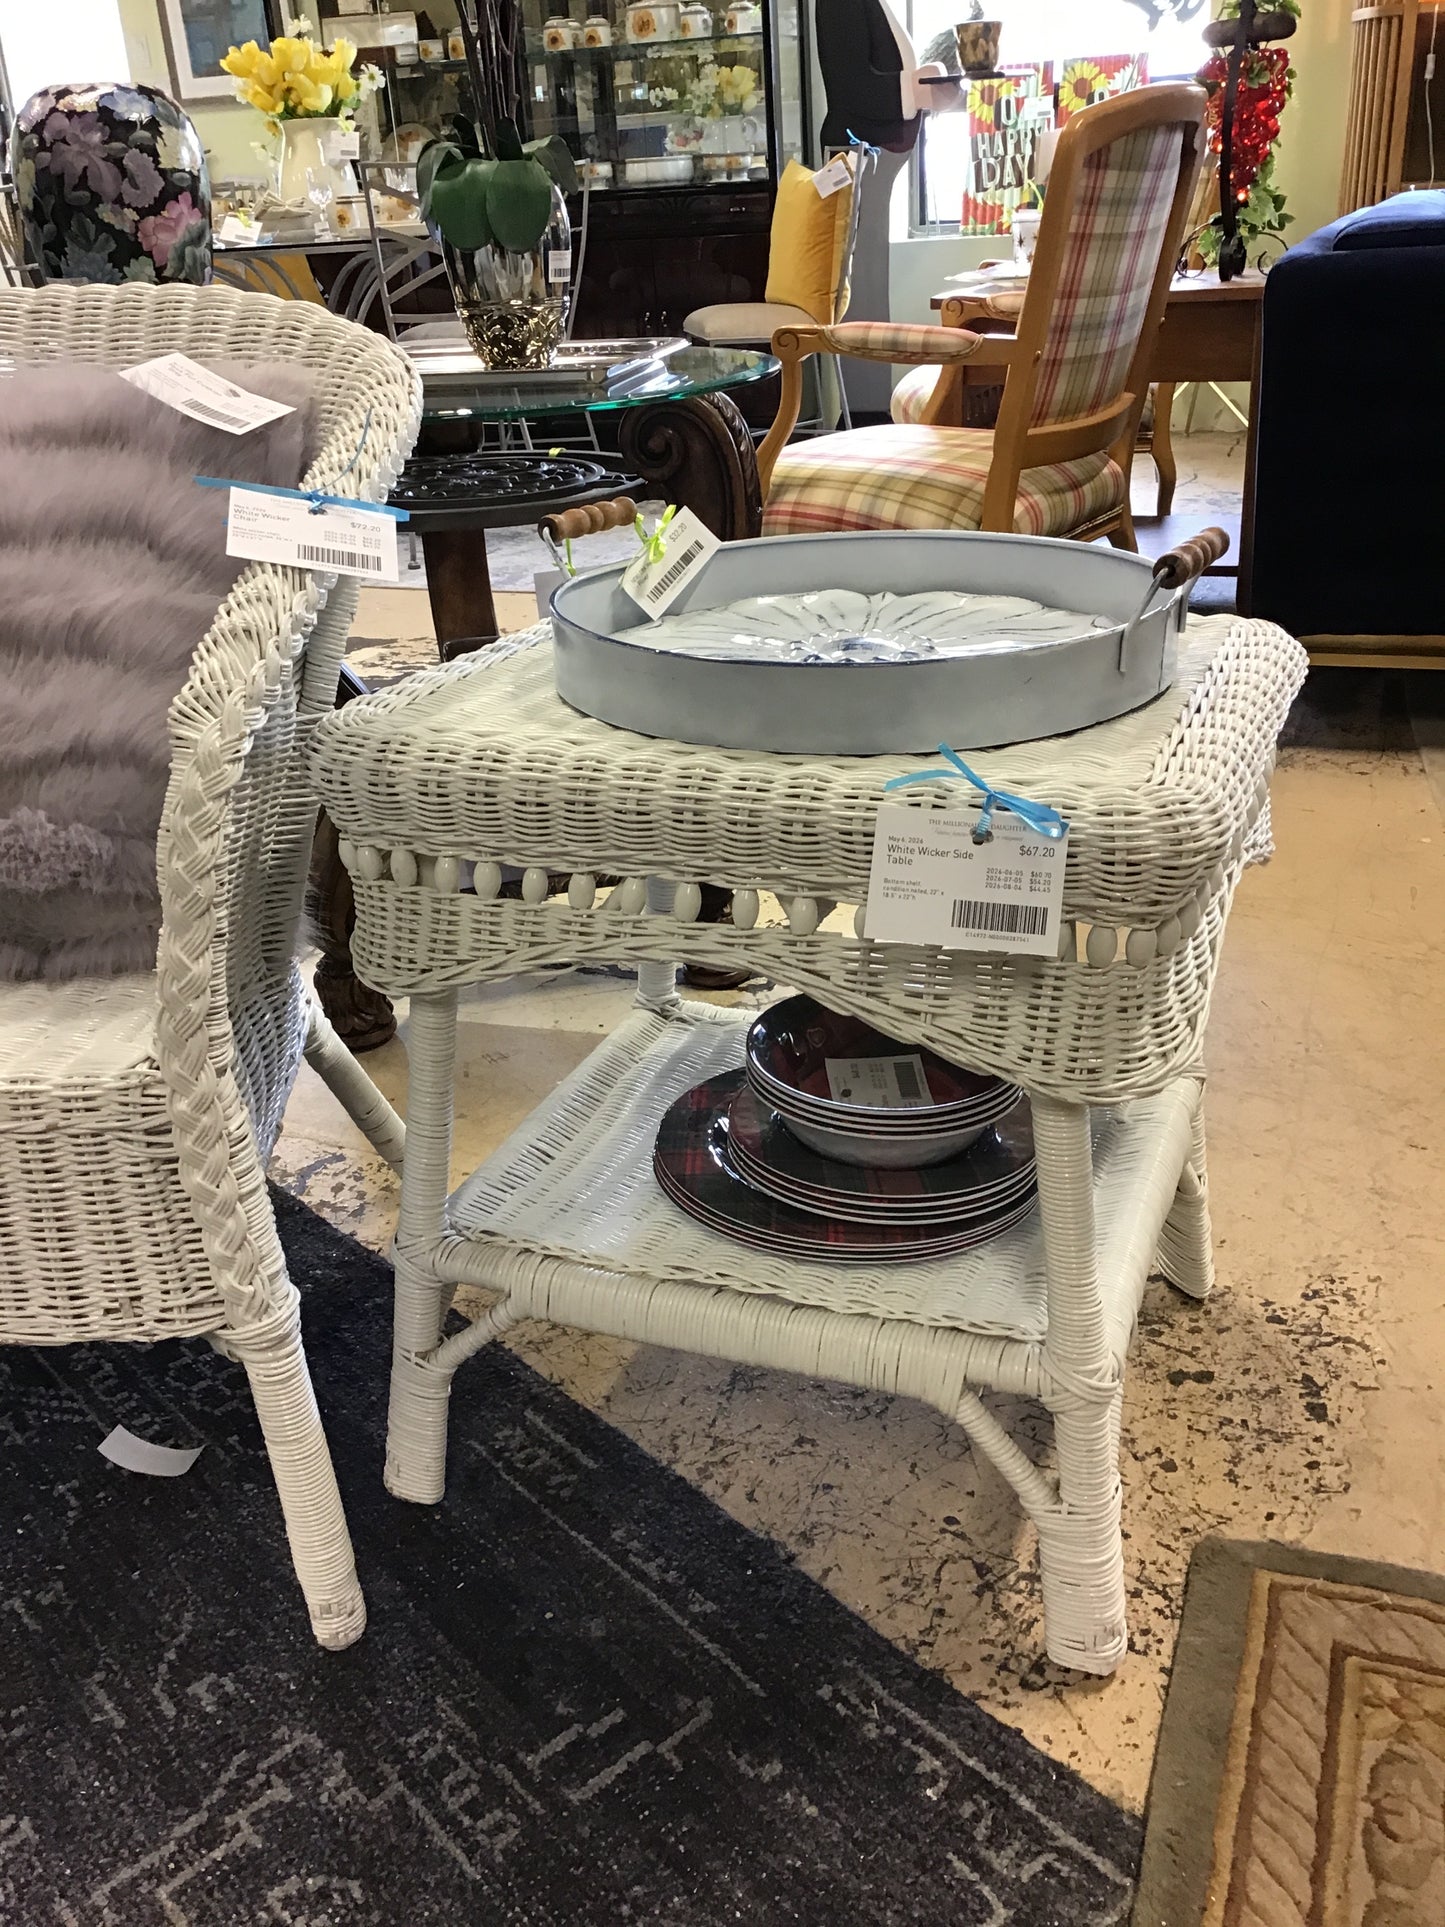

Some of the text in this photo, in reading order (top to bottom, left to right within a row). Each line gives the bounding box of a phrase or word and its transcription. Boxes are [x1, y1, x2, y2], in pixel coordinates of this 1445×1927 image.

[982, 153, 1031, 188] DAY
[233, 508, 259, 517] White
[350, 522, 380, 532] $72.20
[887, 844, 974, 860] White Wicker Side
[1019, 845, 1055, 858] $67.20
[886, 855, 914, 866] Table
